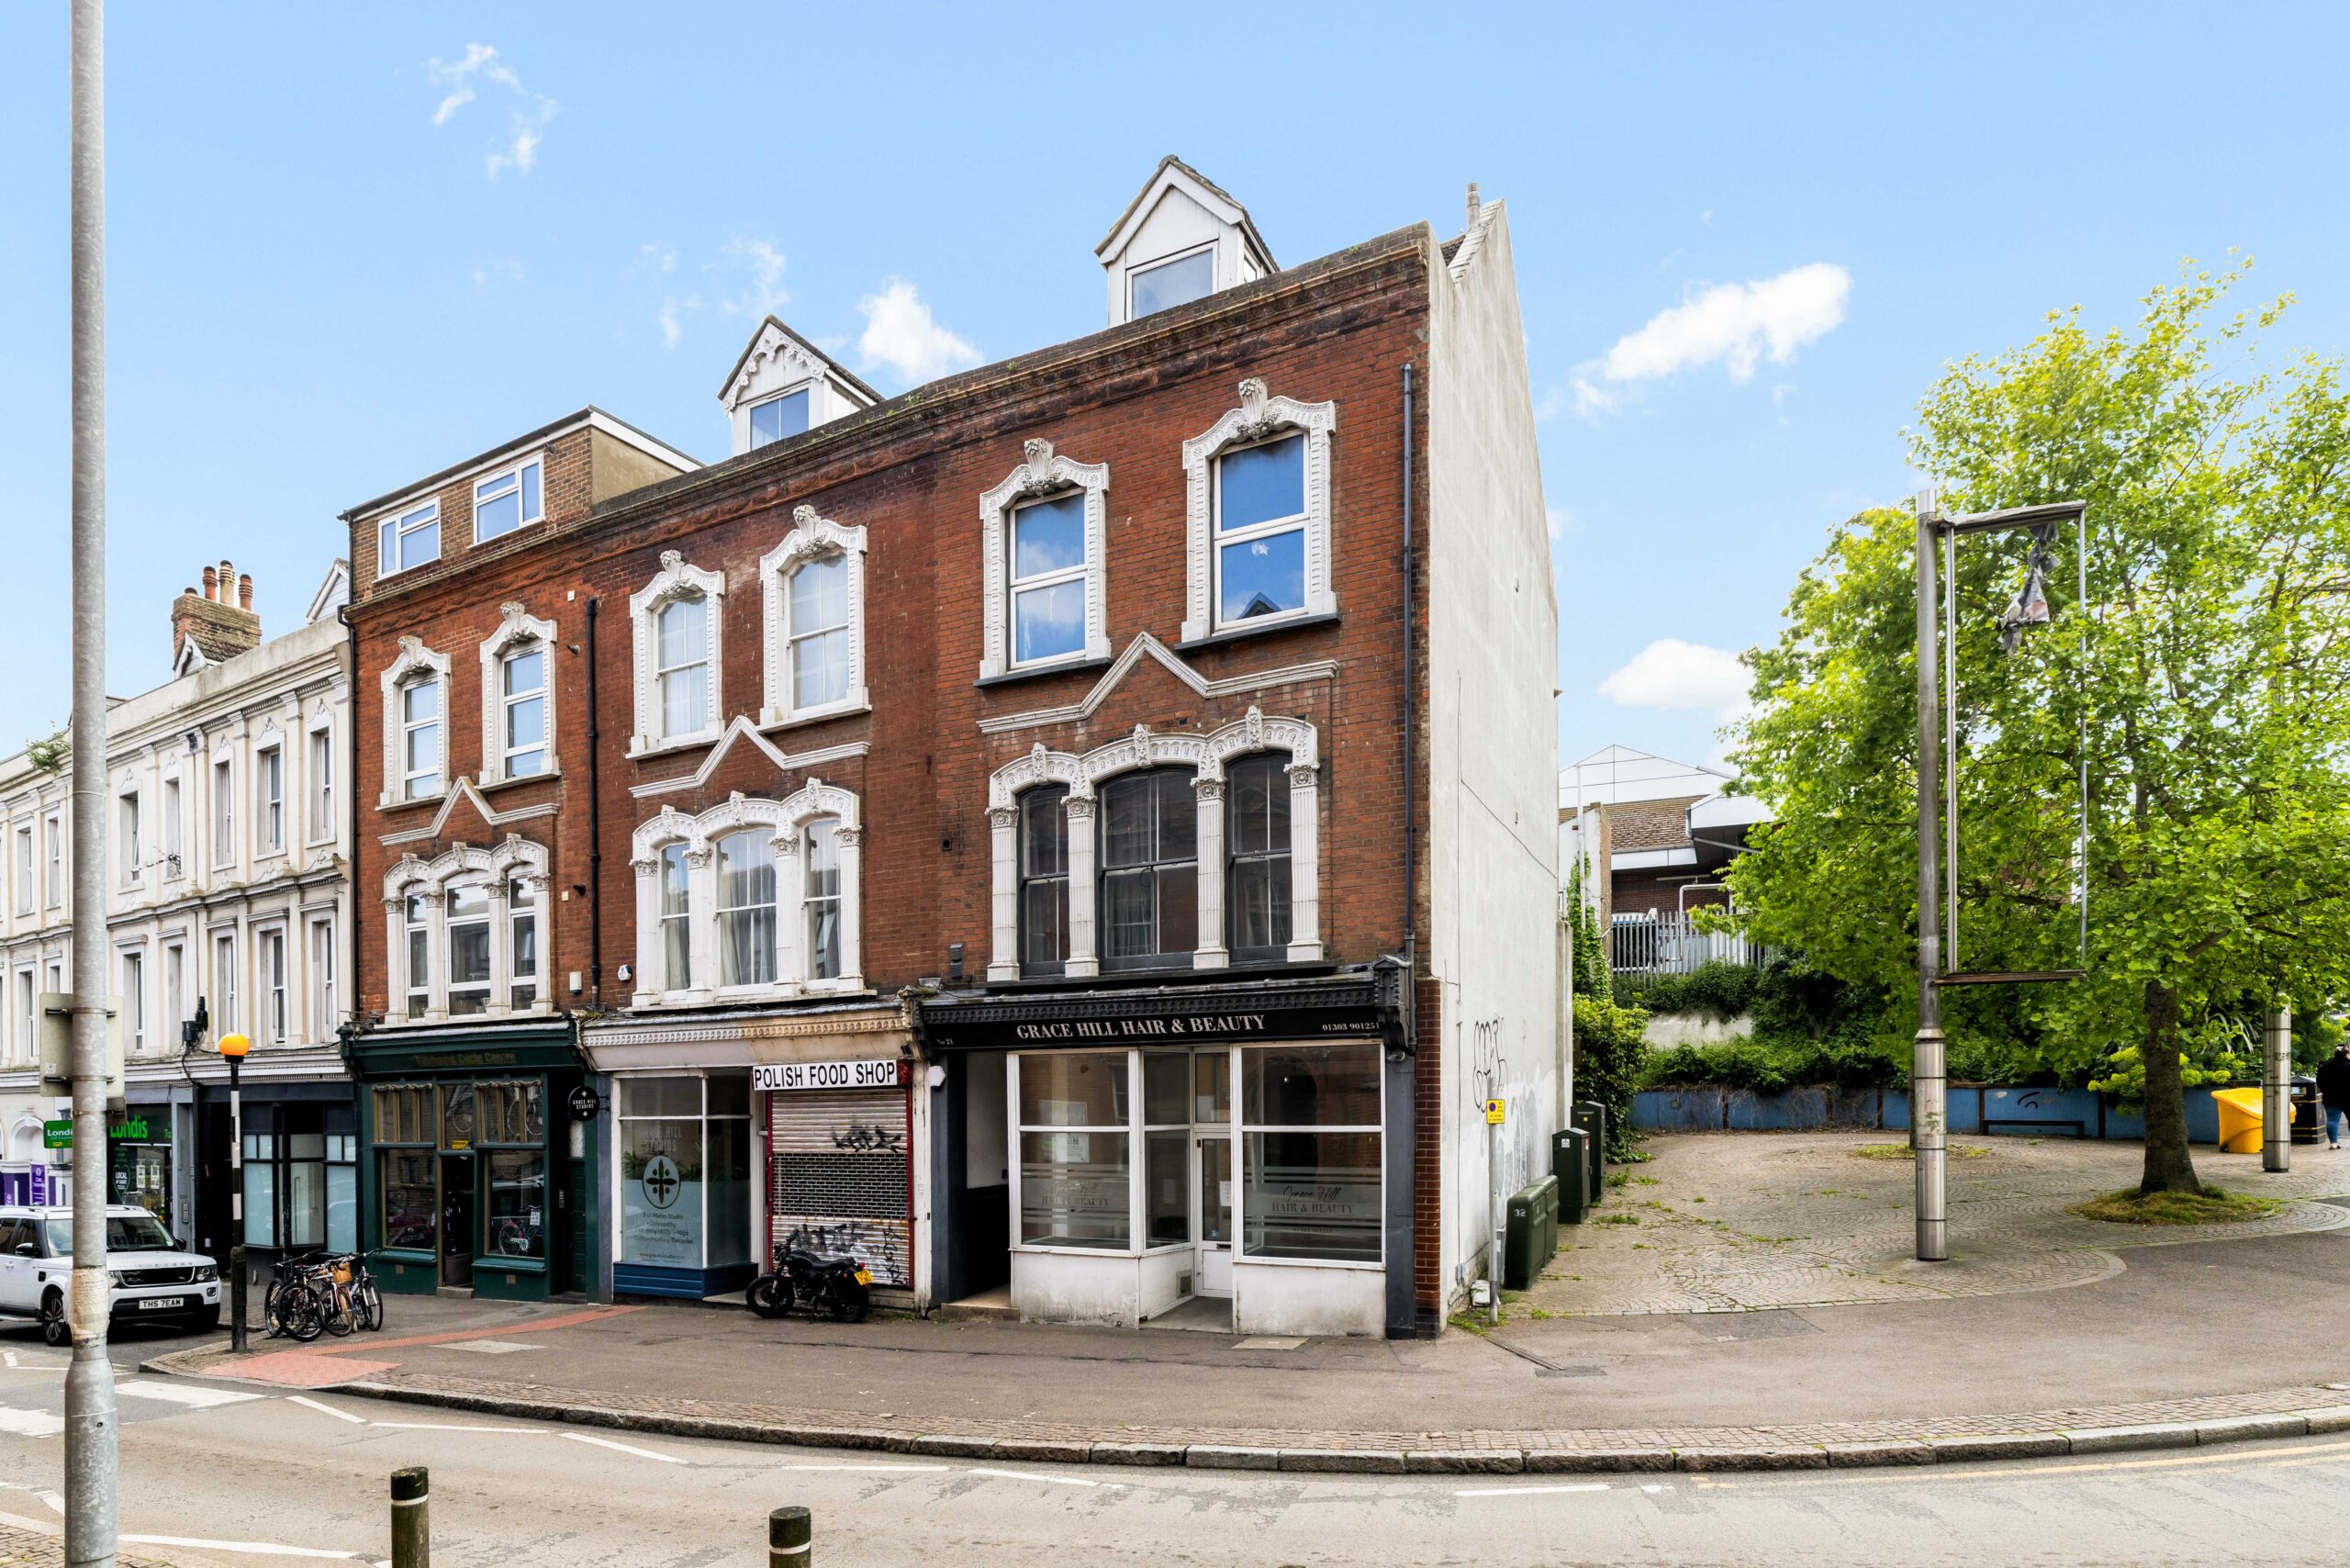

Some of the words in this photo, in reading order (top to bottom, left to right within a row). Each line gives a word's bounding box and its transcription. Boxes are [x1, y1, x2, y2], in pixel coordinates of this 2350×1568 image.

[1016, 1024, 1073, 1039] GRACE
[1075, 1021, 1118, 1036] HILL
[1120, 1019, 1168, 1036] HAIR
[1170, 1018, 1187, 1034] &
[1189, 1014, 1266, 1032] BEAUTY
[1322, 1023, 1348, 1031] 01303
[755, 1066, 803, 1089] POLISH
[810, 1064, 848, 1086] FOOD
[856, 1061, 895, 1084] SHOP
[47, 1127, 73, 1137] Londi
[115, 1171, 128, 1180] LOCAL
[1282, 1185, 1314, 1201] Grace
[1316, 1186, 1342, 1202] Hill
[1042, 1196, 1063, 1206] HAIR
[1271, 1202, 1297, 1212] HAIR
[1300, 1204, 1308, 1213] &
[1312, 1204, 1353, 1214] BEAUTY
[1514, 1208, 1526, 1216] 32
